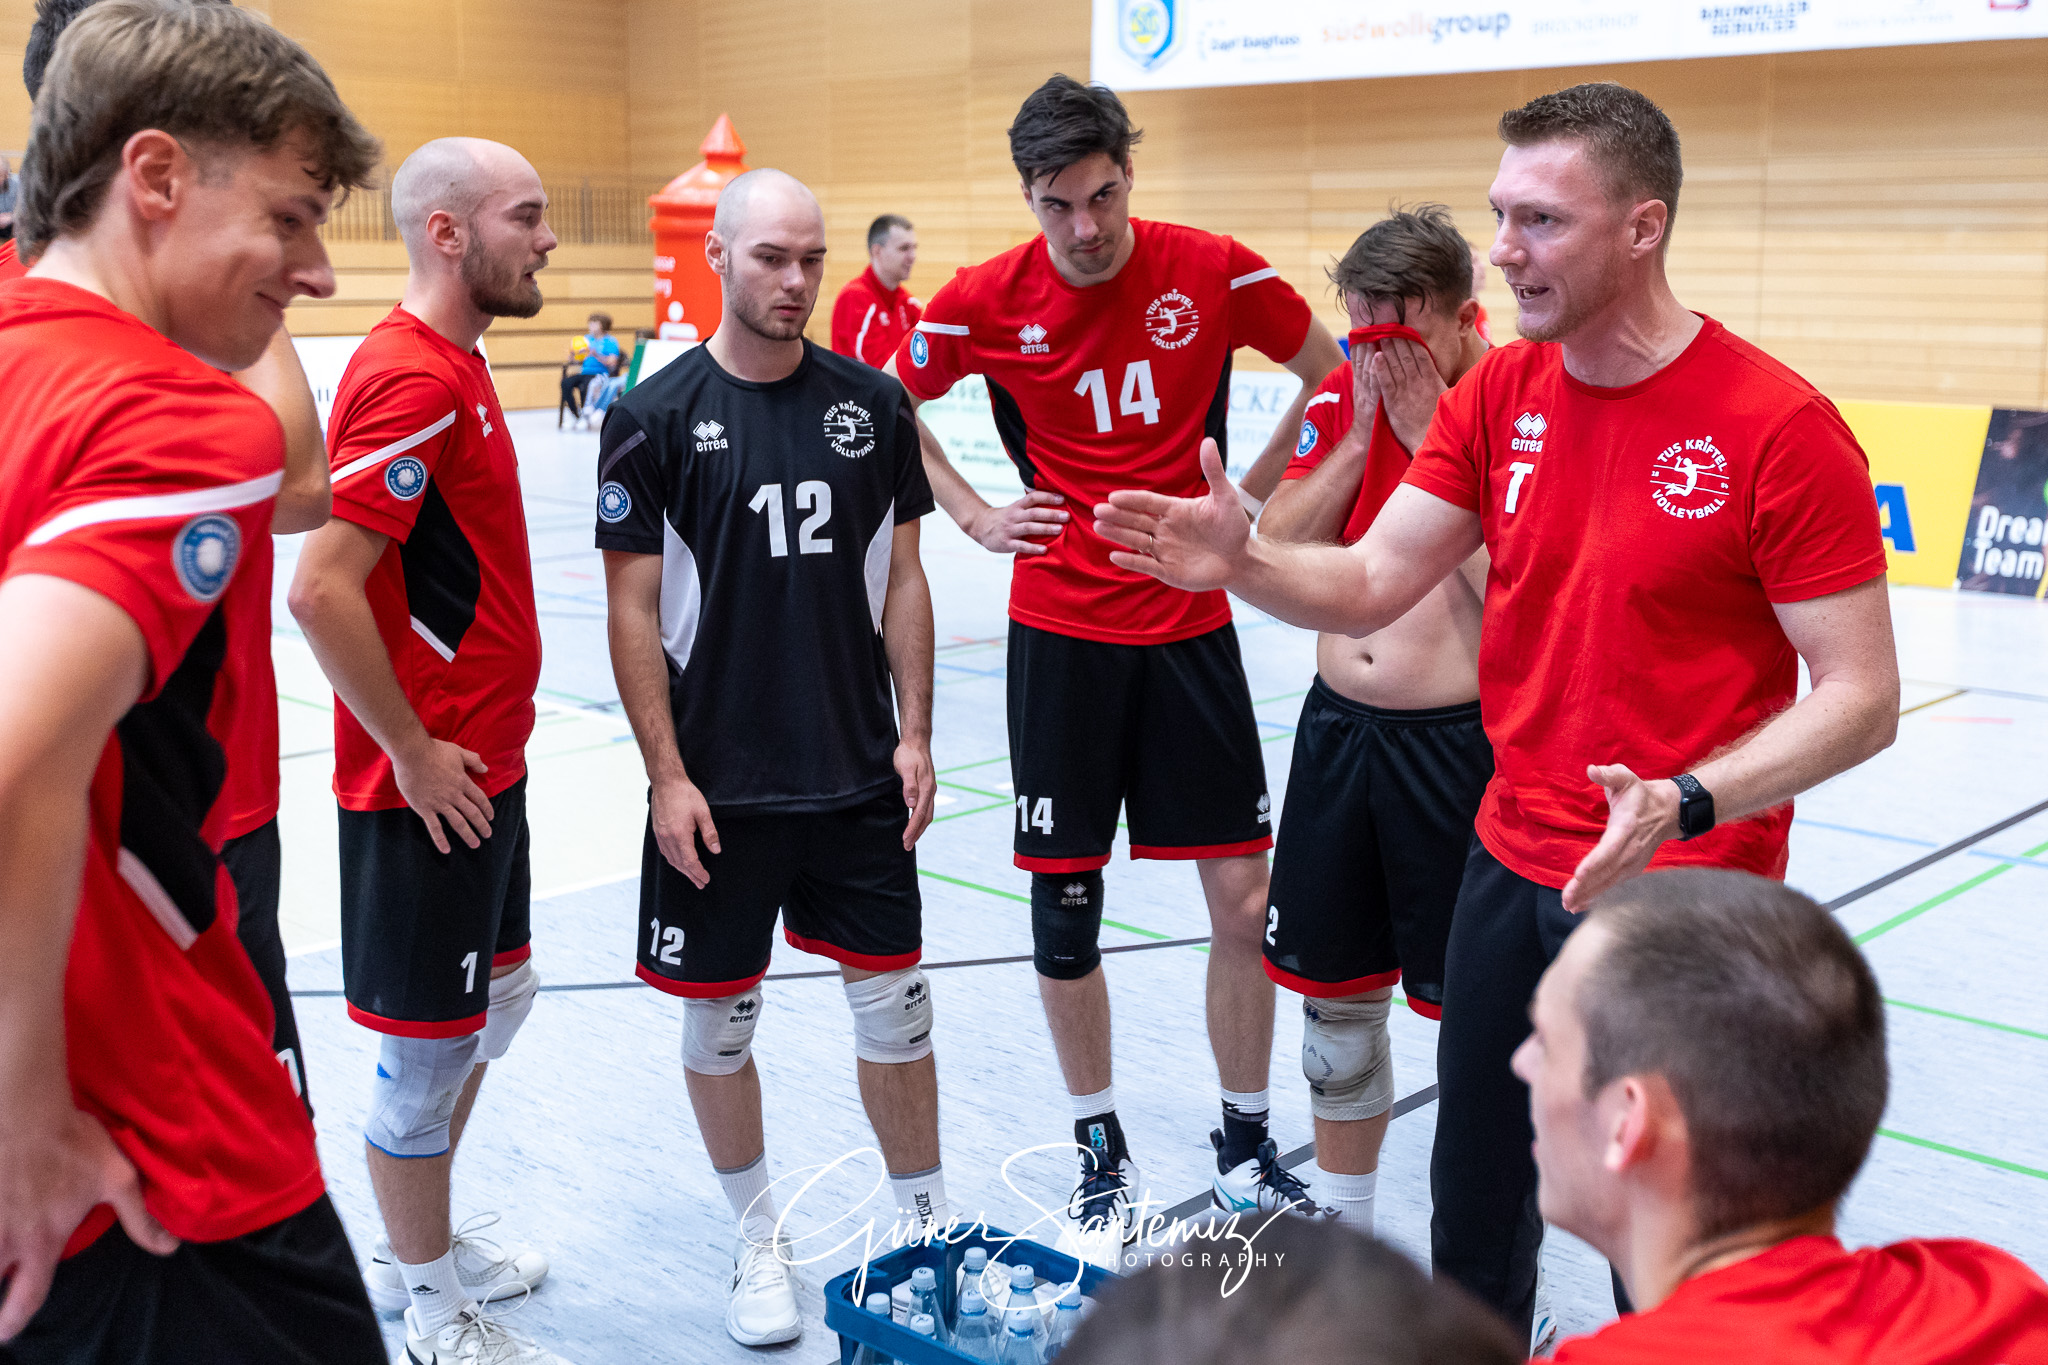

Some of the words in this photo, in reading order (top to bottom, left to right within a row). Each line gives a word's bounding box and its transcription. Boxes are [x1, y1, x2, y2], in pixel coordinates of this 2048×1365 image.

[1146, 299, 1161, 315] TUS
[1020, 343, 1050, 354] errea
[1151, 327, 1199, 349] VOLLEYBALL
[1073, 359, 1161, 434] 14
[824, 405, 839, 421] TUS
[696, 438, 729, 452] errea
[831, 440, 875, 458] VOLLEYBALL
[1511, 437, 1543, 452] errea
[1657, 442, 1682, 463] TUS
[1505, 461, 1535, 514] T
[1652, 488, 1726, 519] VOLLEYBALL
[748, 480, 833, 557] 12
[1872, 484, 1917, 552] A
[1973, 536, 2045, 581] Team
[1016, 795, 1054, 835] 14
[1061, 896, 1088, 906] errea
[650, 917, 685, 966] 12
[460, 951, 478, 993] 1
[904, 993, 927, 1010] errea
[729, 1013, 754, 1023] errea
